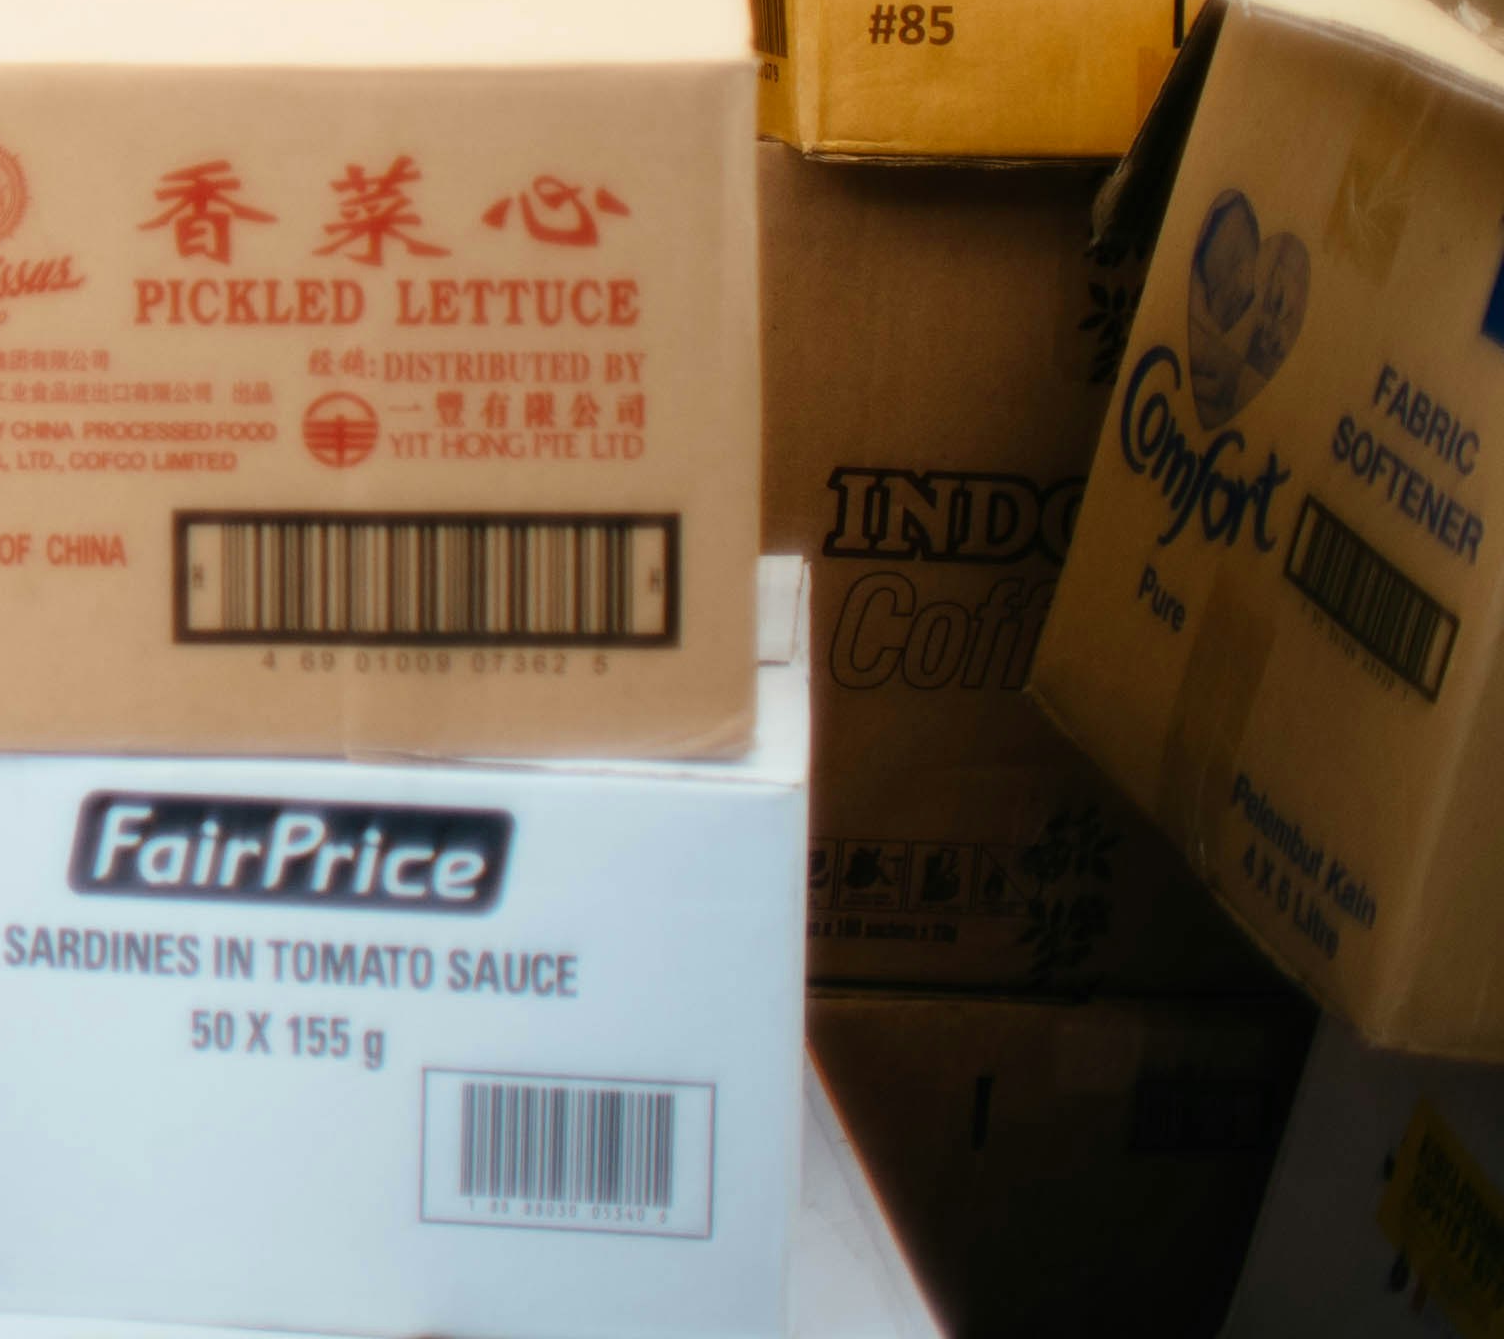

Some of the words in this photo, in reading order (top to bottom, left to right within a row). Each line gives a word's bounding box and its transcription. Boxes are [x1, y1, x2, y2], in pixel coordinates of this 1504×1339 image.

[867, 2, 956, 48] #85
[135, 155, 633, 268] 香菜心
[133, 278, 366, 326] PICKLED
[394, 278, 641, 328] LETTUCE
[382, 350, 591, 385] DISTRIBUTED
[1372, 363, 1481, 476] FABRIC
[1331, 415, 1484, 566] SOFTENER
[46, 533, 128, 568] CHINA
[90, 802, 490, 904] FairPrice
[2, 923, 201, 978] SARDINES
[211, 934, 255, 981] IN
[265, 938, 435, 992] TOMATO
[447, 946, 580, 999] SAUCE
[285, 1013, 352, 1059] 155
